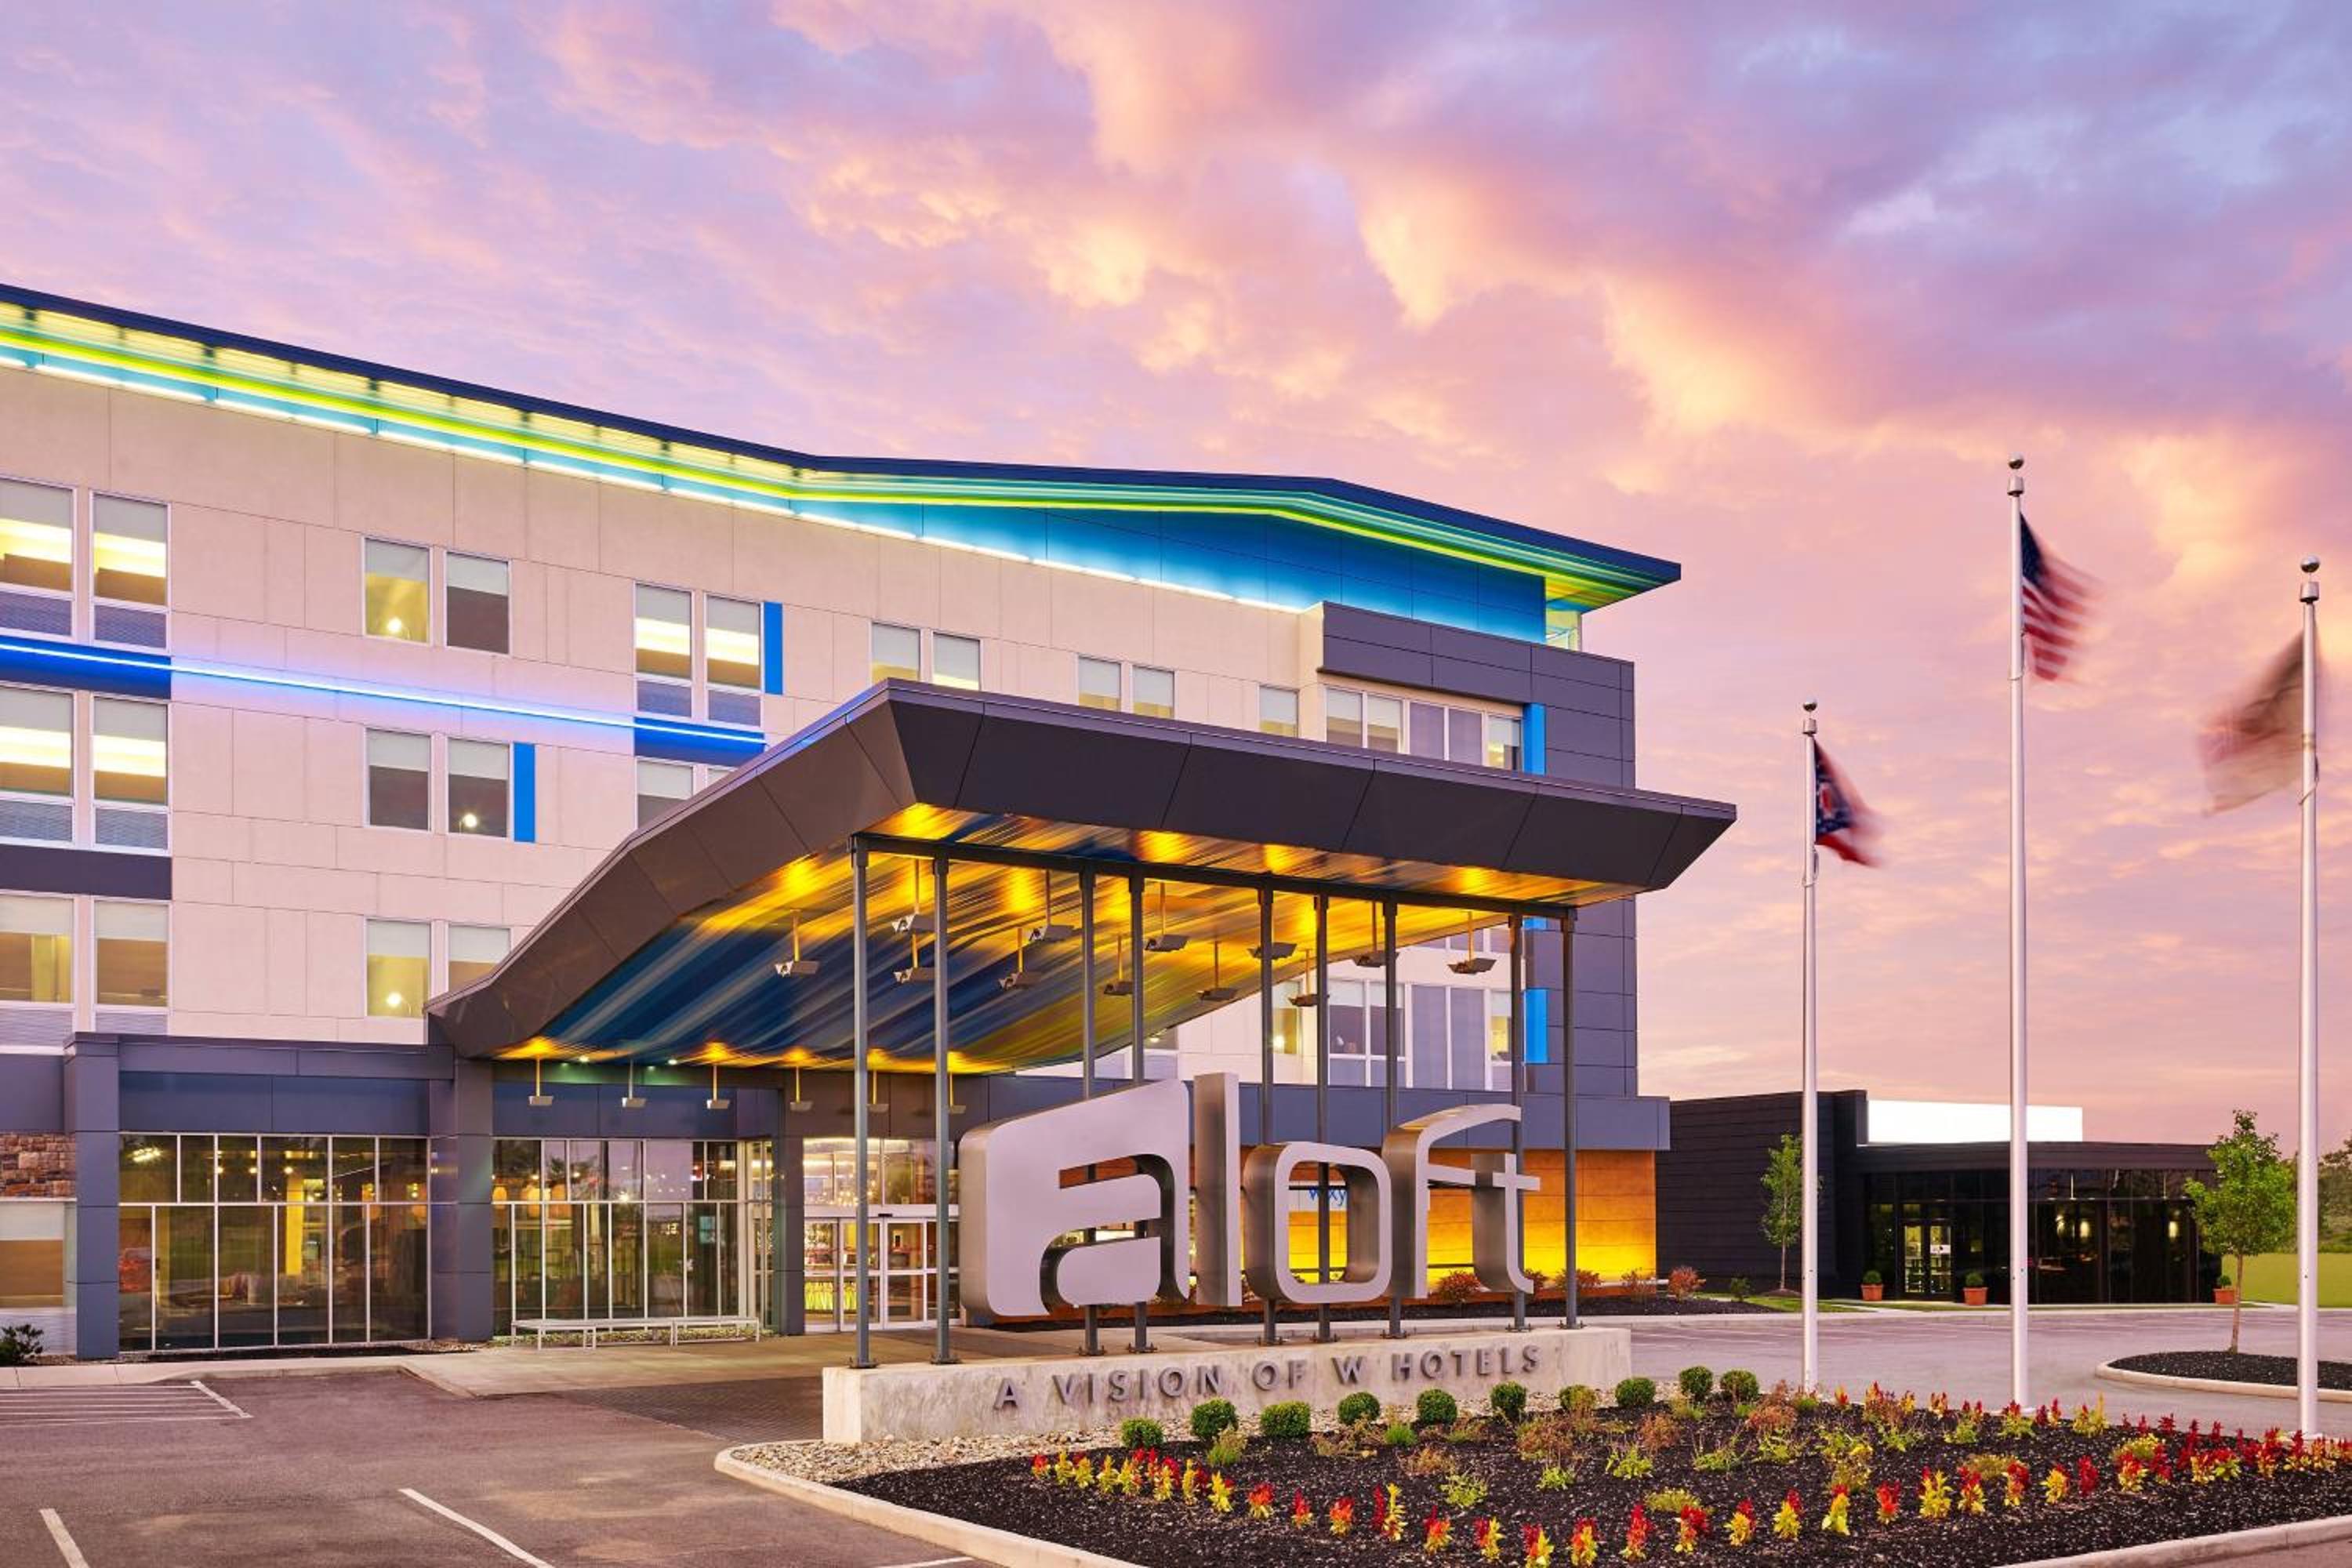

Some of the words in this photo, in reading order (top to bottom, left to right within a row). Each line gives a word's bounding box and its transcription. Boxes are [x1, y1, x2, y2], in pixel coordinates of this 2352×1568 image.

[959, 1073, 1540, 1317] aloft
[993, 1377, 1020, 1410] A
[1052, 1364, 1221, 1406] VISION
[1252, 1359, 1307, 1391] OF
[1331, 1355, 1366, 1385] W
[1392, 1344, 1541, 1381] HOTELS
